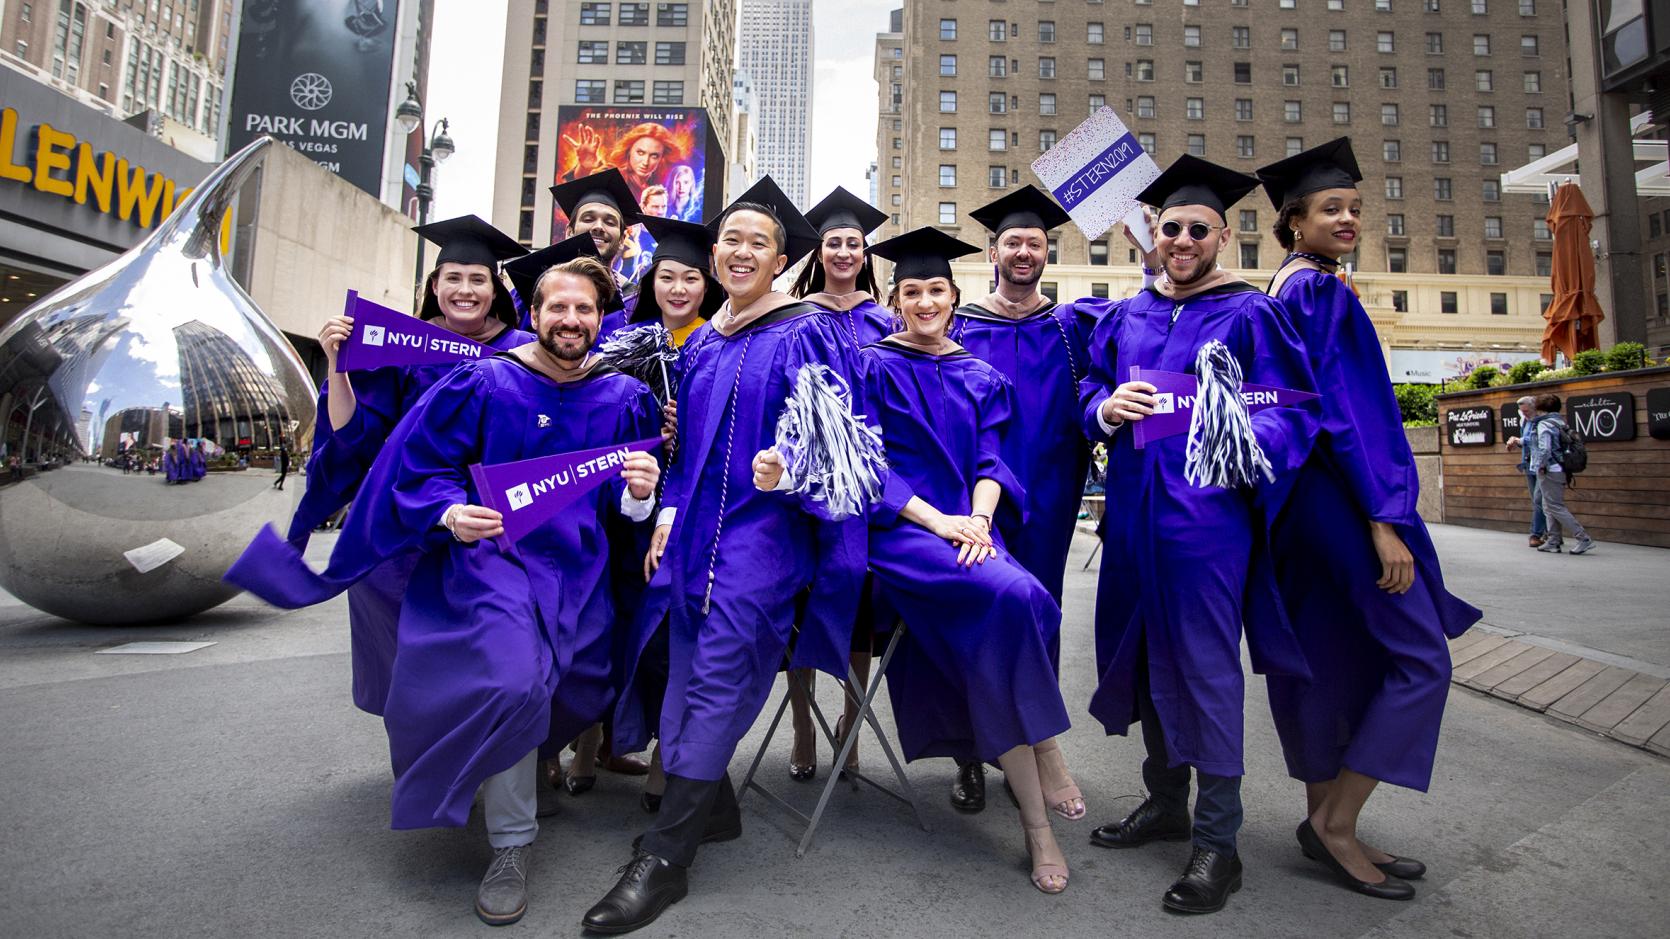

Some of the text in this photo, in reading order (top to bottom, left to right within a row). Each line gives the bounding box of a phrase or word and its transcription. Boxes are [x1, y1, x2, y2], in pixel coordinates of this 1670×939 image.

[245, 114, 368, 141] PARK MGM
[299, 141, 338, 153] VEGAS
[1063, 142, 1134, 204] #STERN2019
[387, 331, 482, 358] NYU STERN
[1502, 418, 1518, 427] THE
[532, 446, 630, 497] NYU STERN
